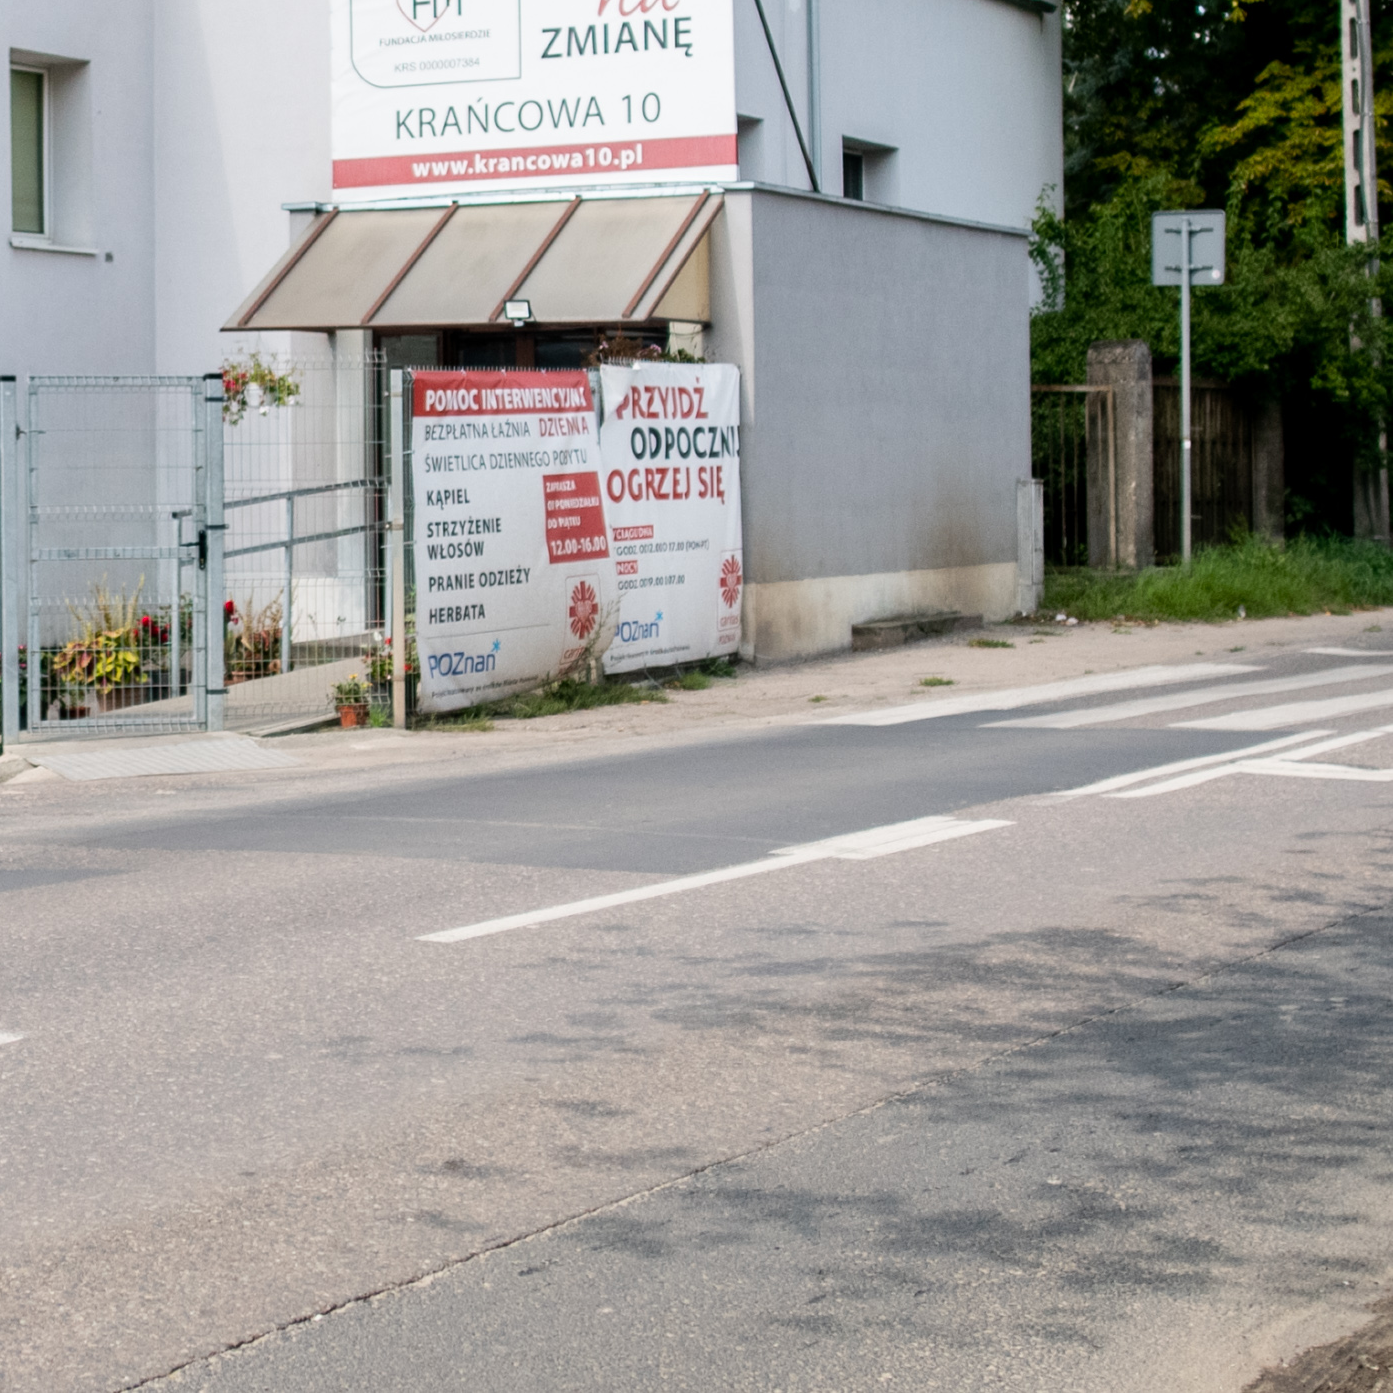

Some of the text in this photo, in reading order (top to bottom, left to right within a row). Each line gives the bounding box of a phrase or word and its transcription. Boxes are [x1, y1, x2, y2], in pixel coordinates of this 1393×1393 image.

[379, 29, 491, 47] FUNDACJA MIŁOSIERDZIE
[541, 17, 694, 59] ZMIANĘ
[394, 61, 417, 73] KRS
[396, 92, 661, 140] KRAŃCOWA 10
[412, 144, 643, 179] www.krancowa10.pl
[425, 389, 480, 412] POMOC
[425, 422, 489, 441] BEZPŁATNA
[491, 419, 531, 438] ŁAŹNIA
[425, 453, 487, 473] ŚWIETLICA
[490, 451, 551, 470] DZIENNEGO
[607, 465, 725, 505] OGRZEJ SIĘ
[426, 489, 470, 510] KĄPIEL
[427, 516, 502, 538] STRZYŻENIE
[427, 540, 484, 561] WŁOSÓW
[551, 535, 607, 556] 12.00-16.00
[429, 565, 530, 593] PRANIE ODZIEŻY
[429, 604, 486, 625] HERBATA
